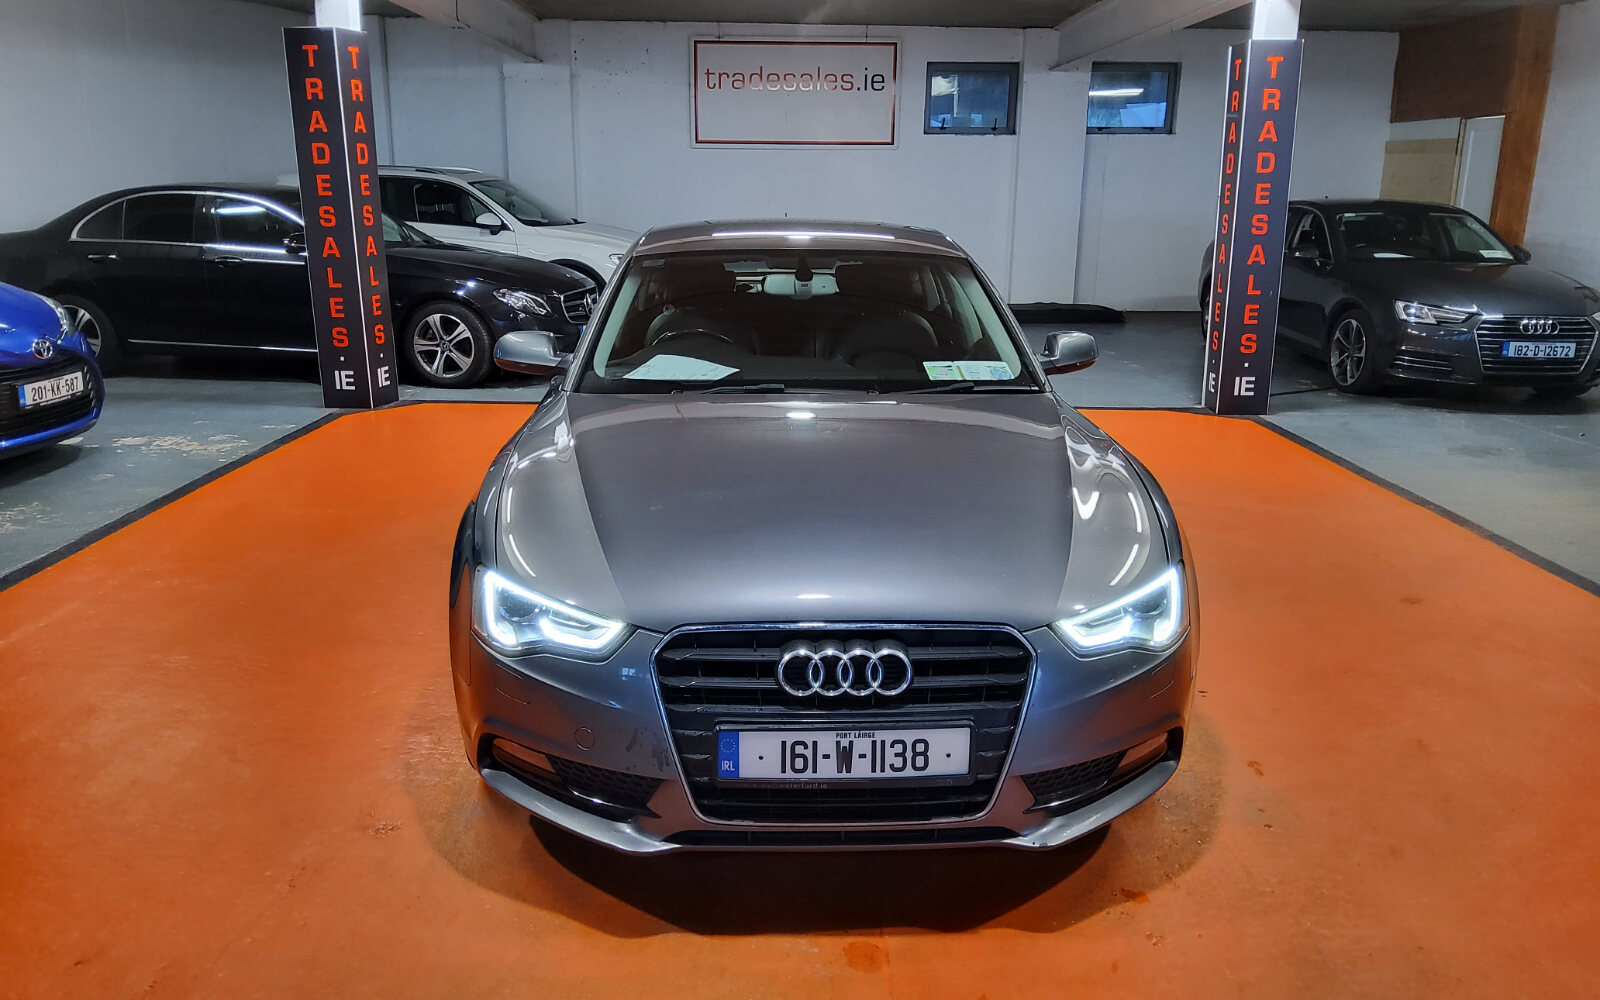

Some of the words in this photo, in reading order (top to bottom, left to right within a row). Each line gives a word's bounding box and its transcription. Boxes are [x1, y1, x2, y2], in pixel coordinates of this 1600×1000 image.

[704, 65, 886, 92] tradesales.ie
[1513, 344, 1571, 357] 182-D-12672
[31, 376, 79, 402] 201-KK-587
[721, 760, 736, 771] IRL
[780, 738, 930, 774] 161-W-1138
